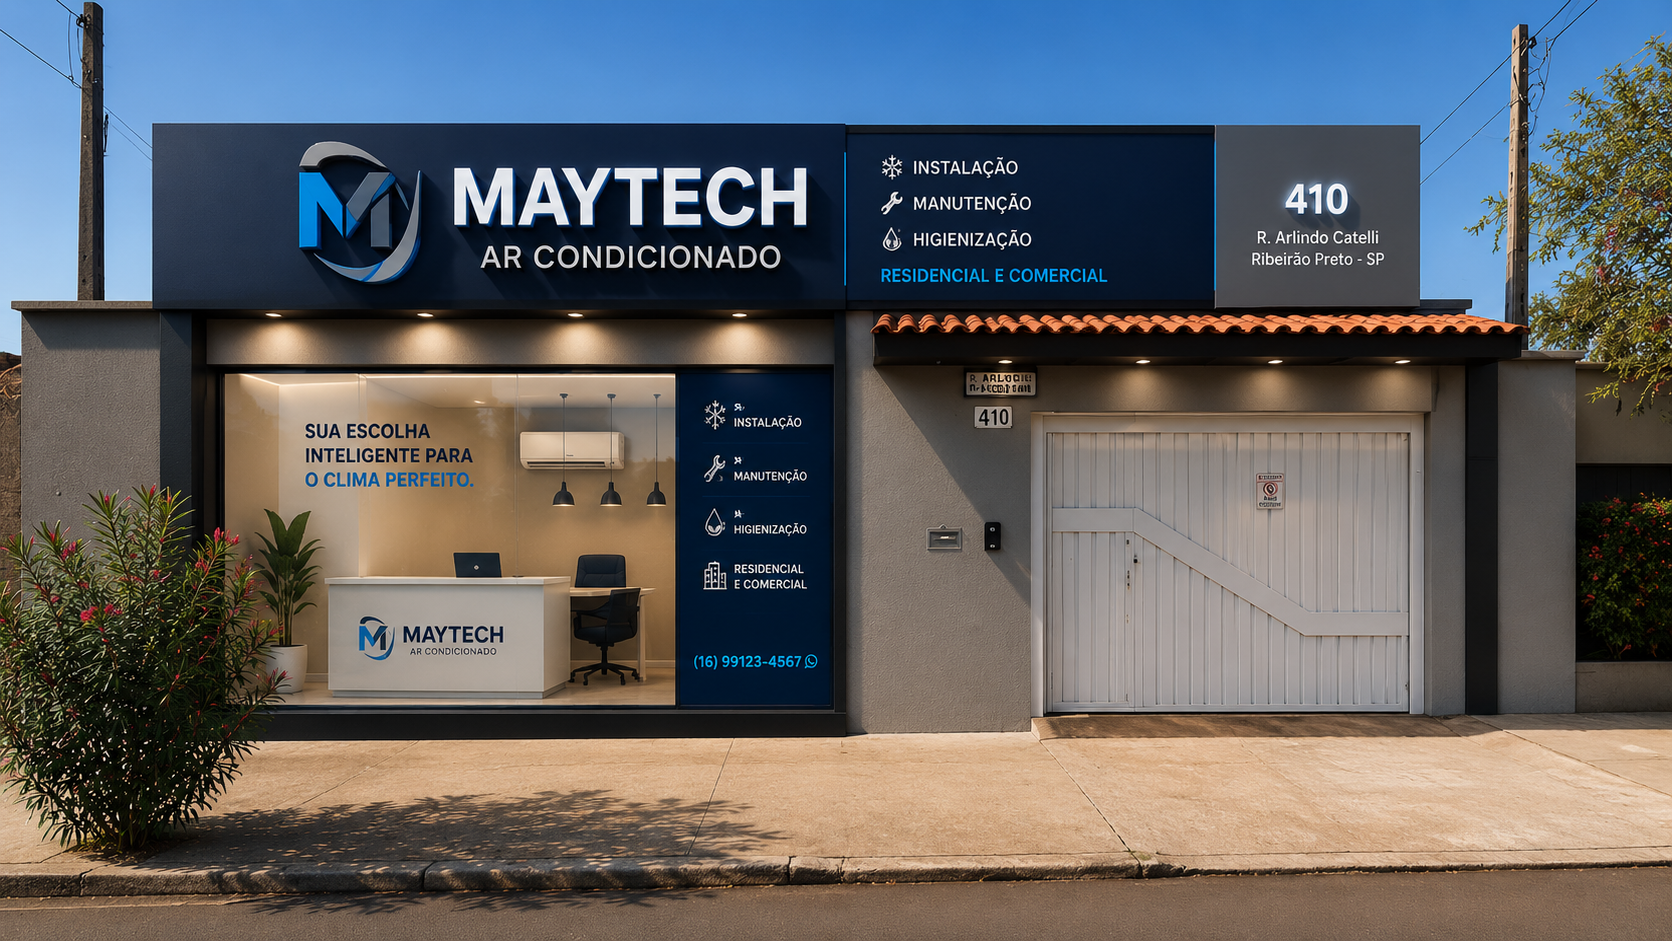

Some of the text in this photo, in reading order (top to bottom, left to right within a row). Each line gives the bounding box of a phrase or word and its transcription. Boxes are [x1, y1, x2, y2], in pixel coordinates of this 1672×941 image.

[913, 157, 1019, 179] INSTALAÇÃO
[453, 167, 807, 227] MAYTECH
[913, 192, 1032, 214] MANUTENÇÃO
[1285, 183, 1349, 215] 410
[913, 229, 1032, 250] HIGIENIZAÇÃO
[1257, 231, 1379, 244] R. Arlindo Catelli
[480, 245, 781, 270] AR CONDICIONADO
[1251, 251, 1310, 266] Ribeirão
[1315, 253, 1352, 266] Preto
[1366, 253, 1385, 266] SP
[881, 268, 1108, 283] RESIDENCIAL E COMERCIAL
[734, 415, 802, 429] INSTALAÇÃO
[979, 409, 1008, 426] 410
[305, 424, 431, 439] SUA ESCOLHA
[305, 448, 473, 463] INTELIGENTE PARA
[305, 472, 474, 488] O CLIMA PERFEITO.
[734, 468, 807, 483] MANUTENÇÃO
[734, 522, 807, 536] HIGIENIZAÇÃO
[734, 564, 804, 574] RESIDENCIAL
[734, 579, 807, 589] E COMERCIAL
[403, 626, 504, 643] MAYTECH
[694, 656, 801, 669] (16) 99123-4567
